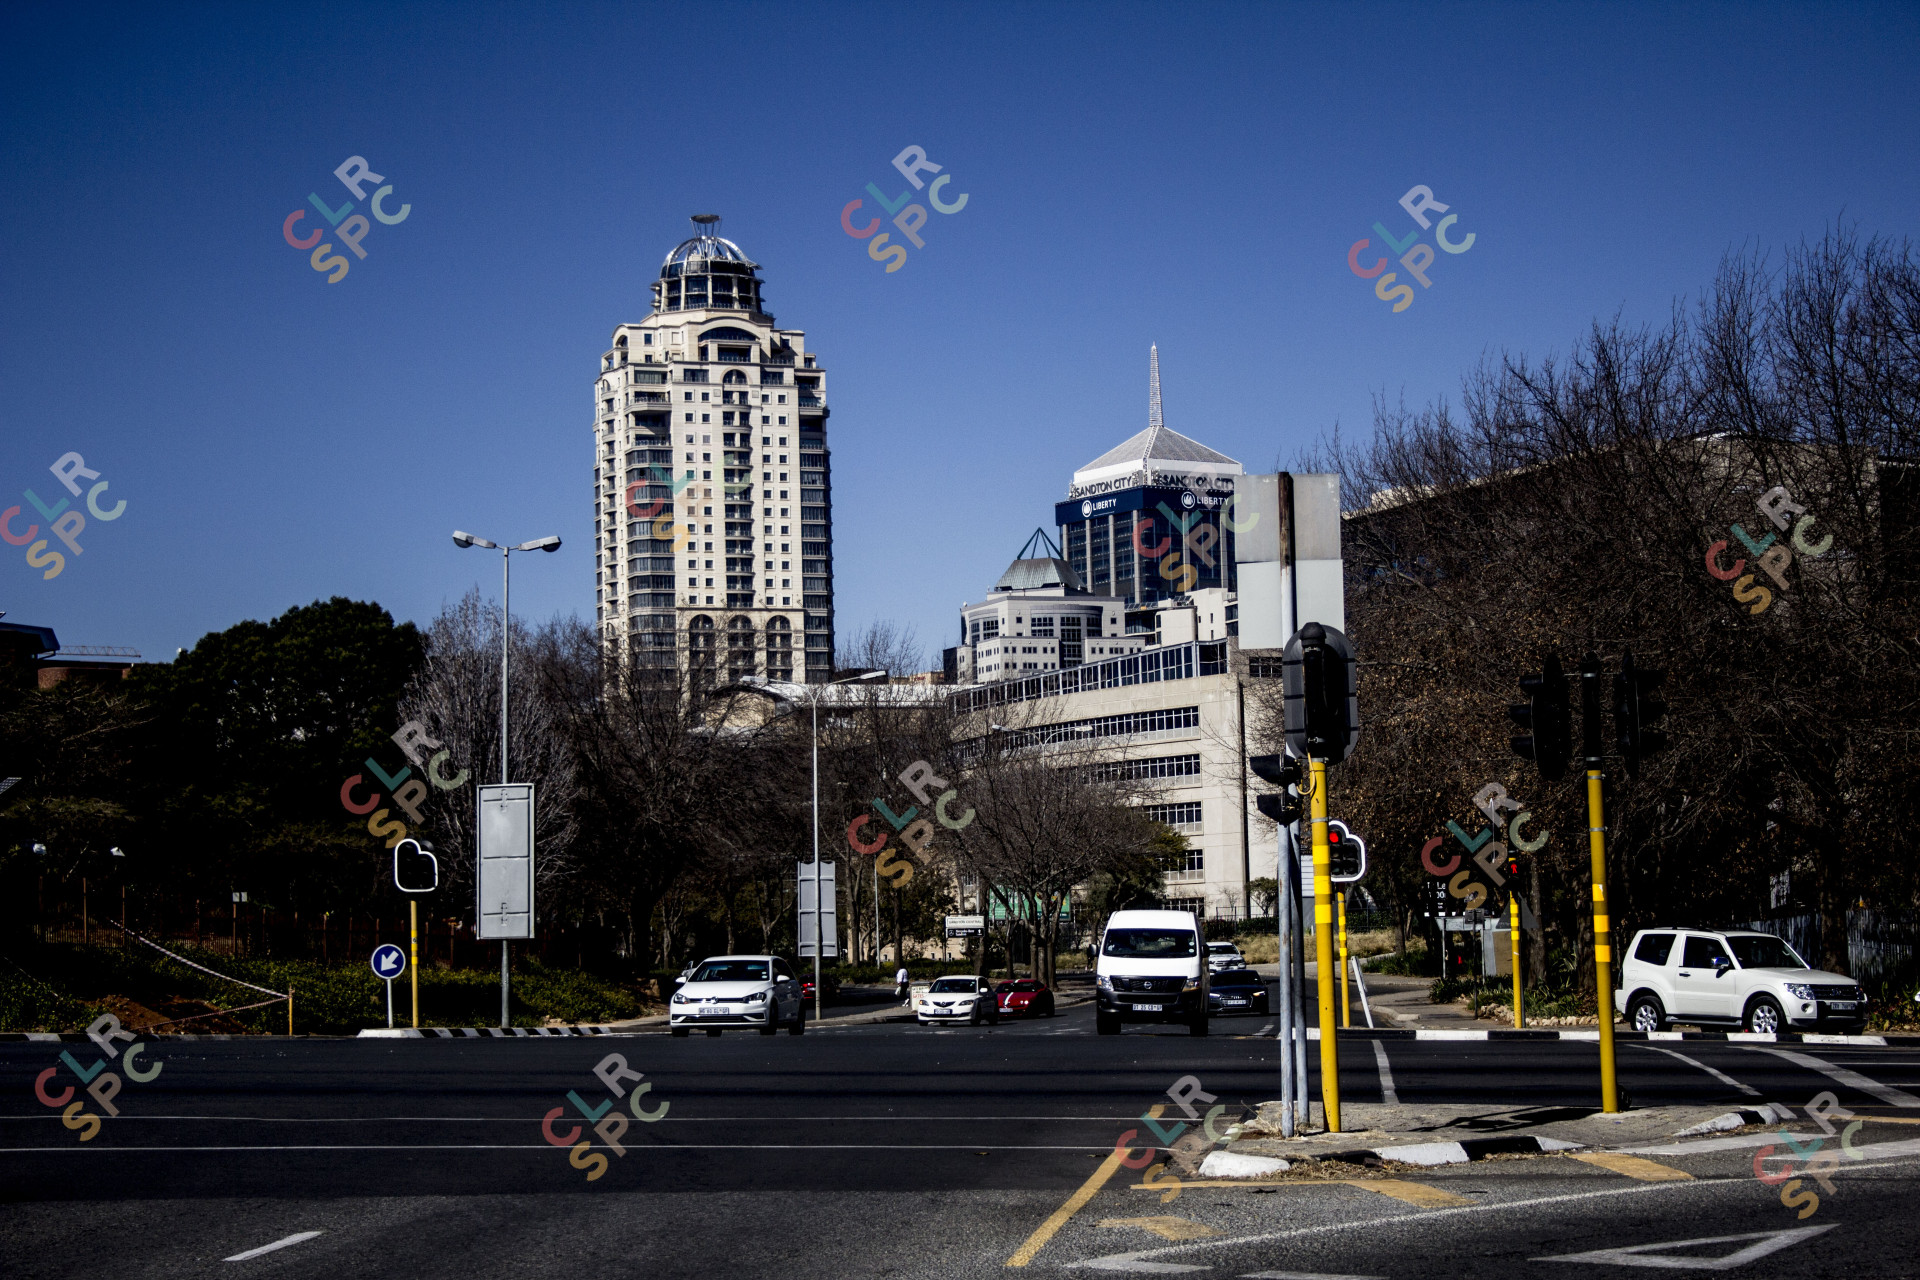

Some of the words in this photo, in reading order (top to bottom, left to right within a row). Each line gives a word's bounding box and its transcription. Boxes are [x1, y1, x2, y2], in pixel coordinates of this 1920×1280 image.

[1075, 480, 1112, 498] SANDTON
[1113, 476, 1132, 489] CITY
[1163, 474, 1213, 489] SANDTON
[1092, 498, 1117, 511] LIBERTY
[1196, 496, 1229, 506] LIBERTY
